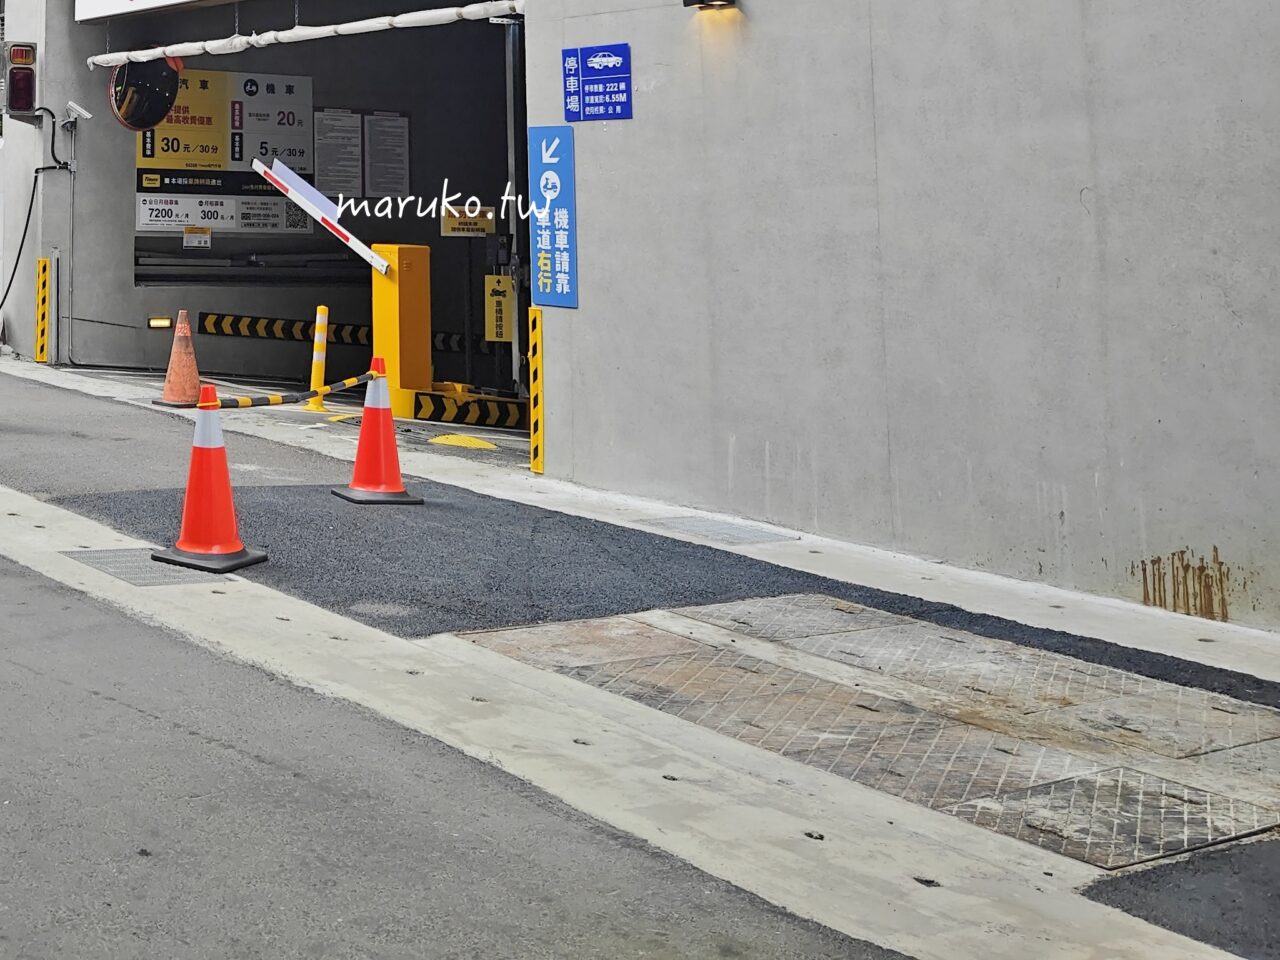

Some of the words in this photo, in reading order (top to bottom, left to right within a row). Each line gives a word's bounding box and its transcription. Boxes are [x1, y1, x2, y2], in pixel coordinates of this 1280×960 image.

[179, 78, 209, 91] 汽車
[266, 83, 295, 96] 機車
[564, 57, 580, 113] 停車場
[536, 208, 552, 293] 車道右行
[554, 208, 570, 294] 機車請靠
